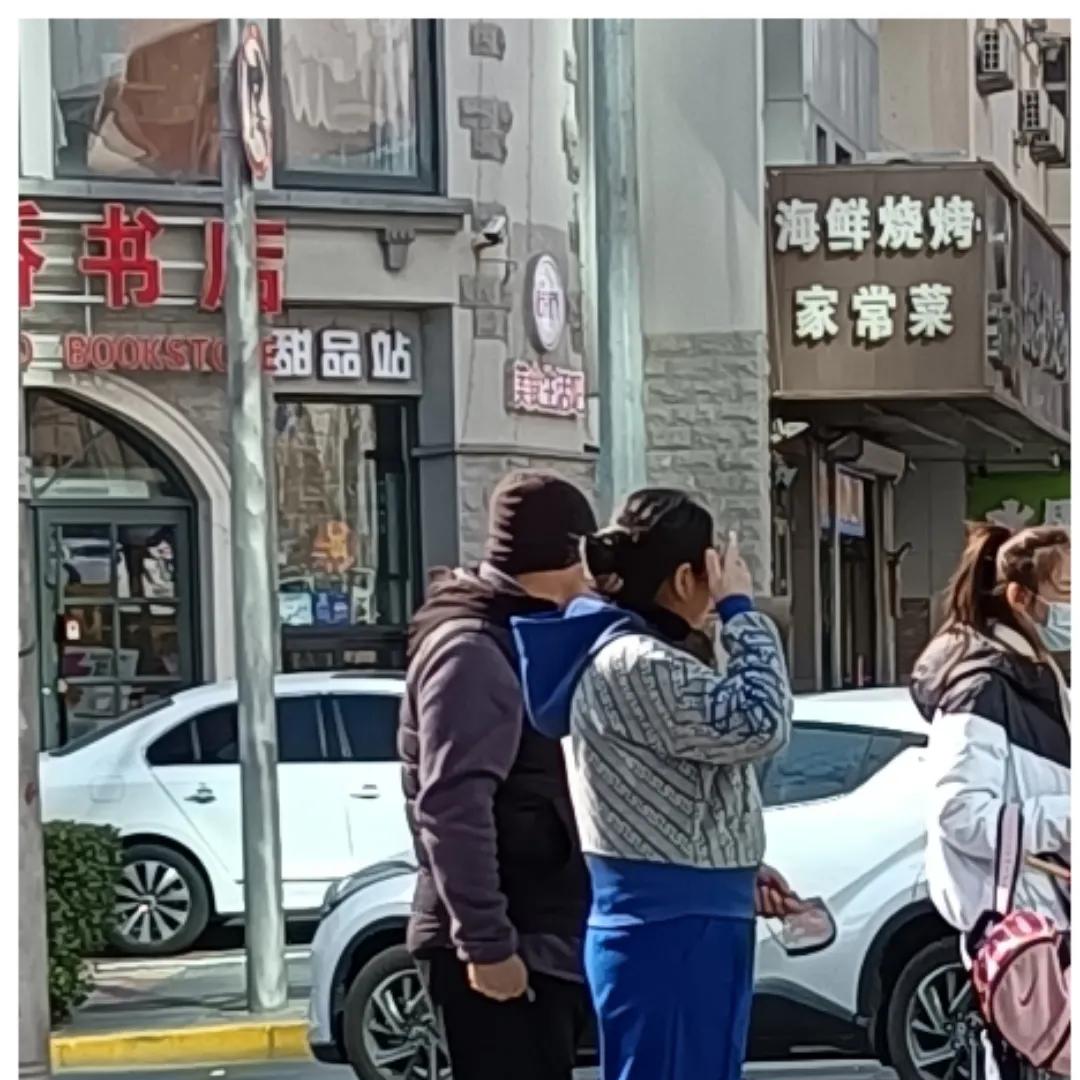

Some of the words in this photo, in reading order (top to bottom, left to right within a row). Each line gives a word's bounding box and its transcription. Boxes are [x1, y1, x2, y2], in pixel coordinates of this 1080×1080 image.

[775, 195, 975, 252] 海鲜烧烤
[796, 283, 954, 340] 家常菜
[64, 333, 278, 372] BOOKSTOE
[273, 328, 412, 379] 甜品站
